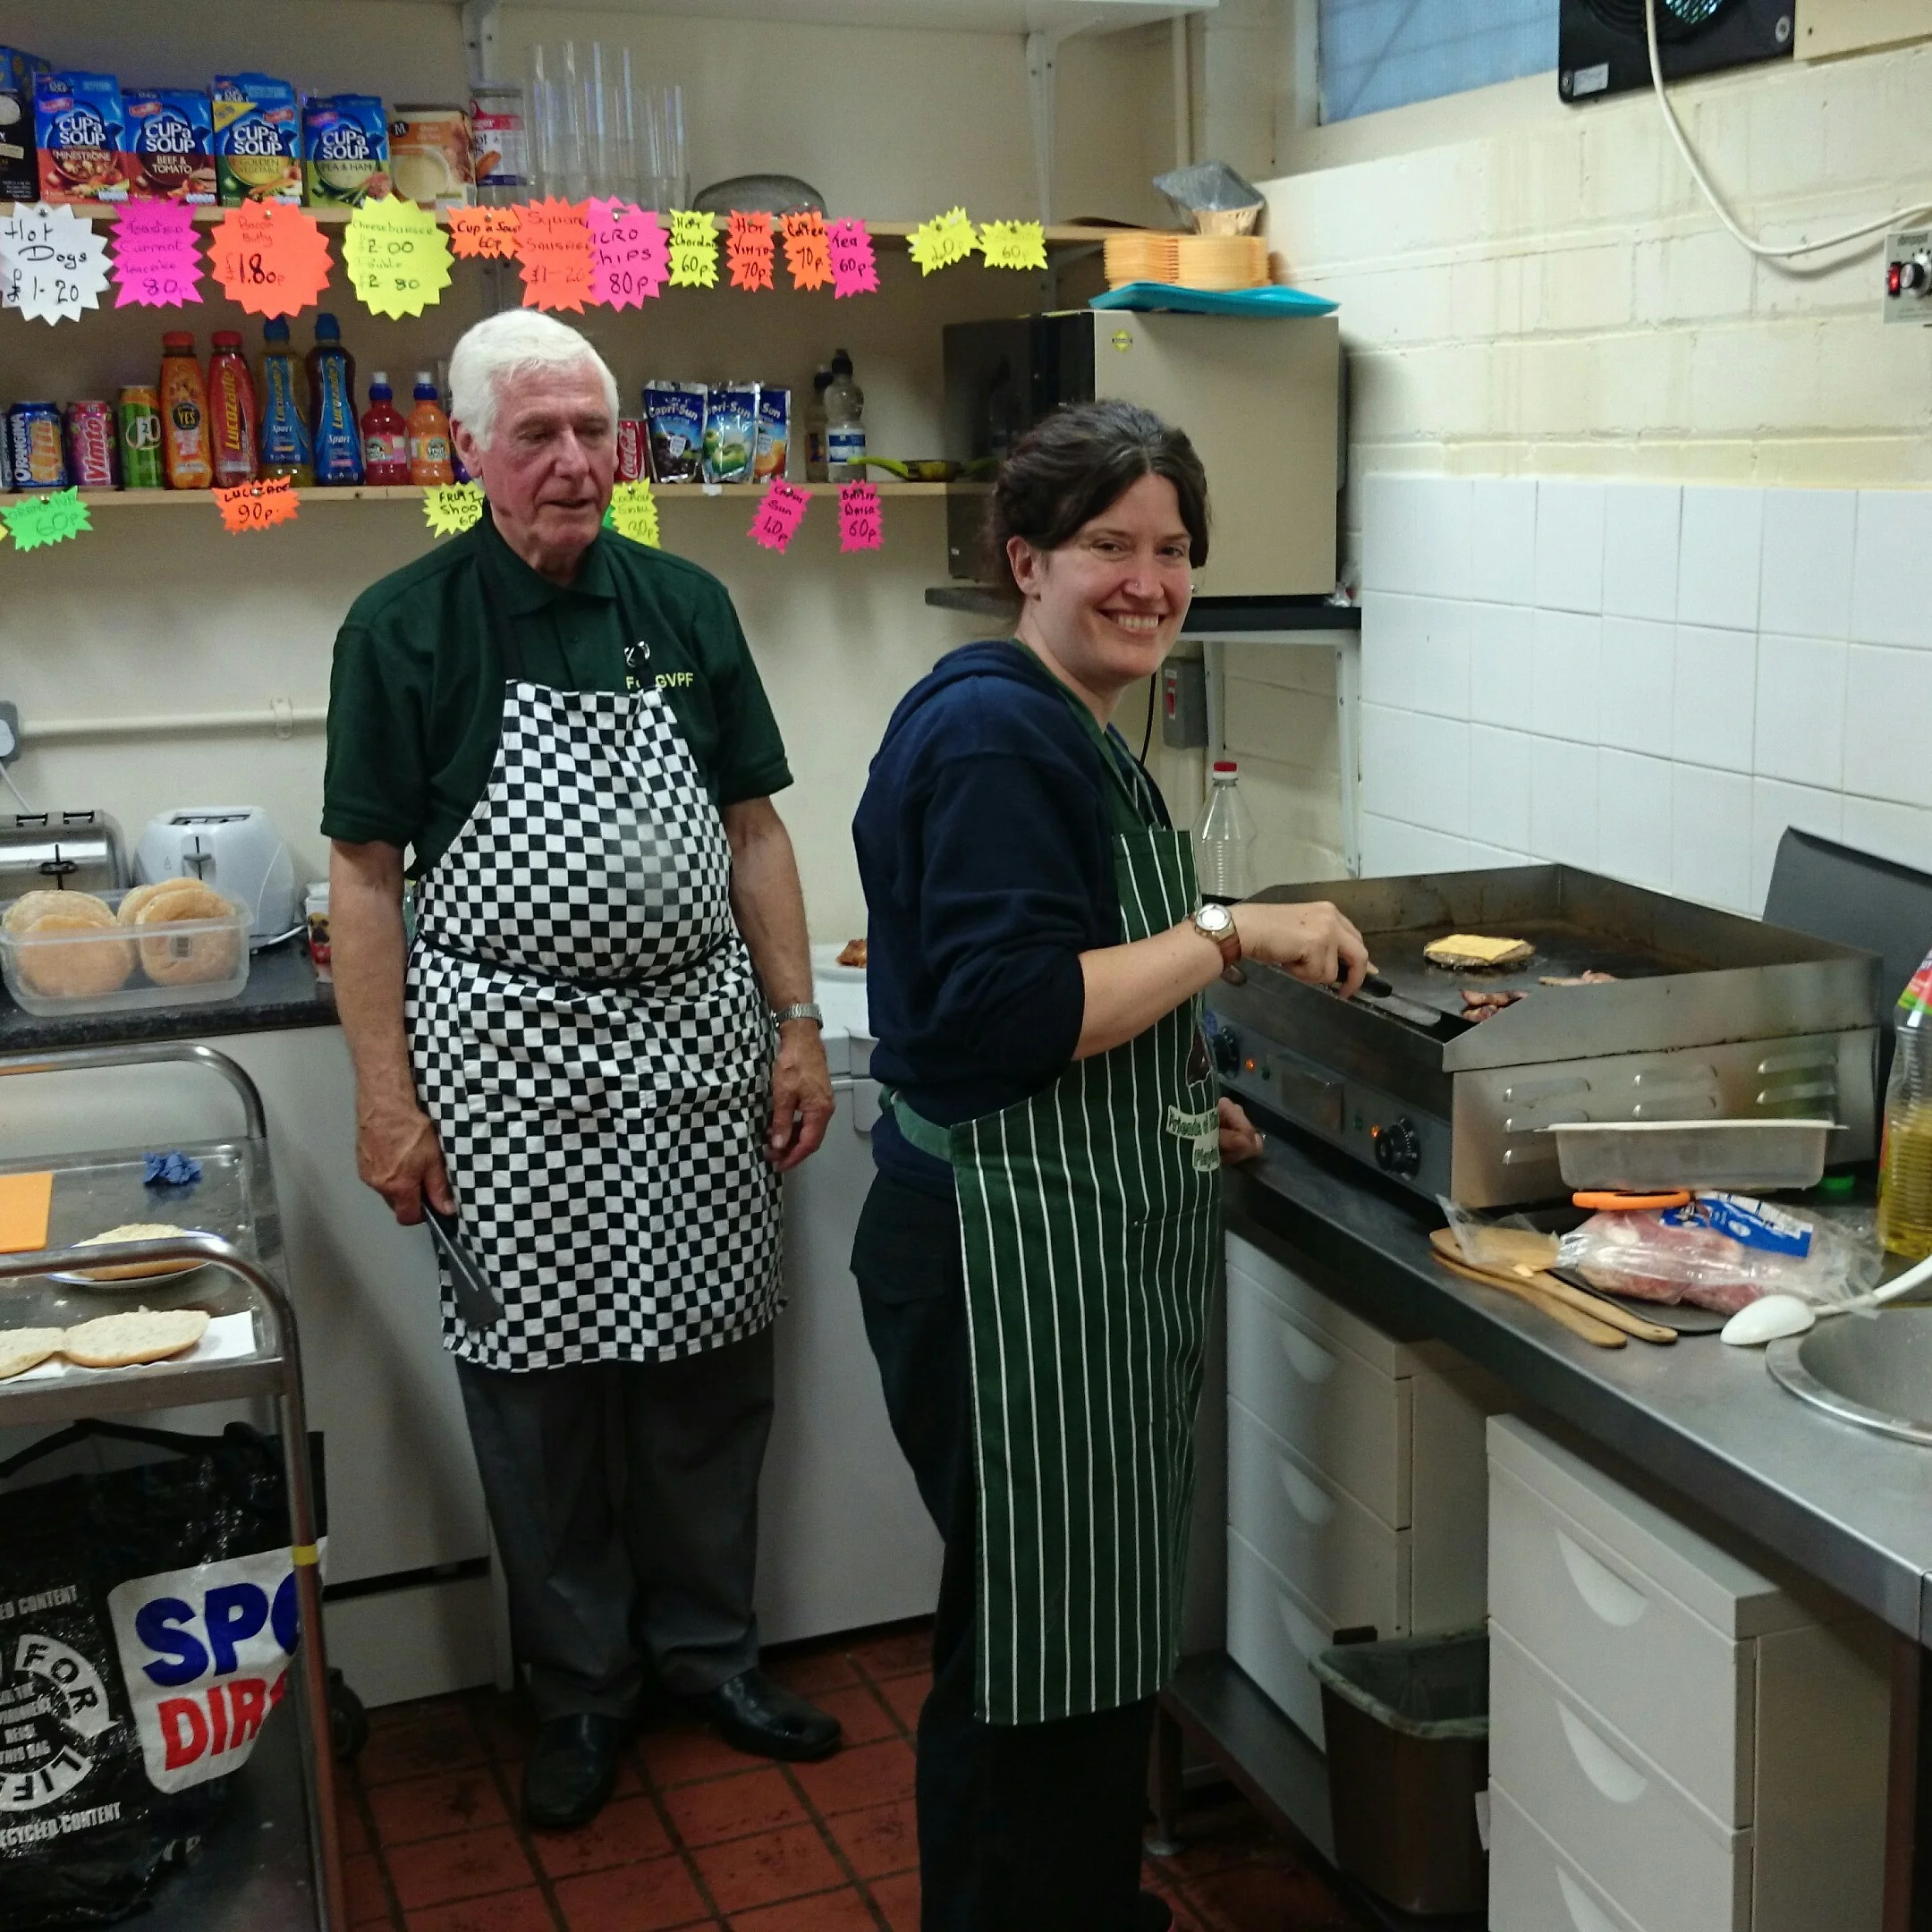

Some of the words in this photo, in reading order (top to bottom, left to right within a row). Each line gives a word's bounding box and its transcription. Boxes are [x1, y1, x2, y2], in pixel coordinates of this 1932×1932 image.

[394, 123, 406, 134] M
[59, 131, 106, 146] SOUP
[146, 137, 195, 153] SOUP
[234, 140, 283, 156] SOUP
[55, 149, 111, 162] MINESTRONE
[157, 155, 178, 165] BEEF
[323, 144, 369, 160] SOUP
[152, 164, 193, 174] TOMATO
[4, 218, 54, 242] Hot
[18, 245, 88, 270] Dogs
[682, 254, 708, 278] 60p
[796, 246, 824, 273] 70p
[741, 260, 767, 282] 70p
[839, 257, 867, 278] 60p
[609, 271, 649, 296] 80p
[179, 409, 196, 426] YES
[83, 417, 112, 486] Vimto
[238, 502, 273, 524] 90p
[849, 519, 877, 544] 60p
[655, 672, 694, 689] GVPF
